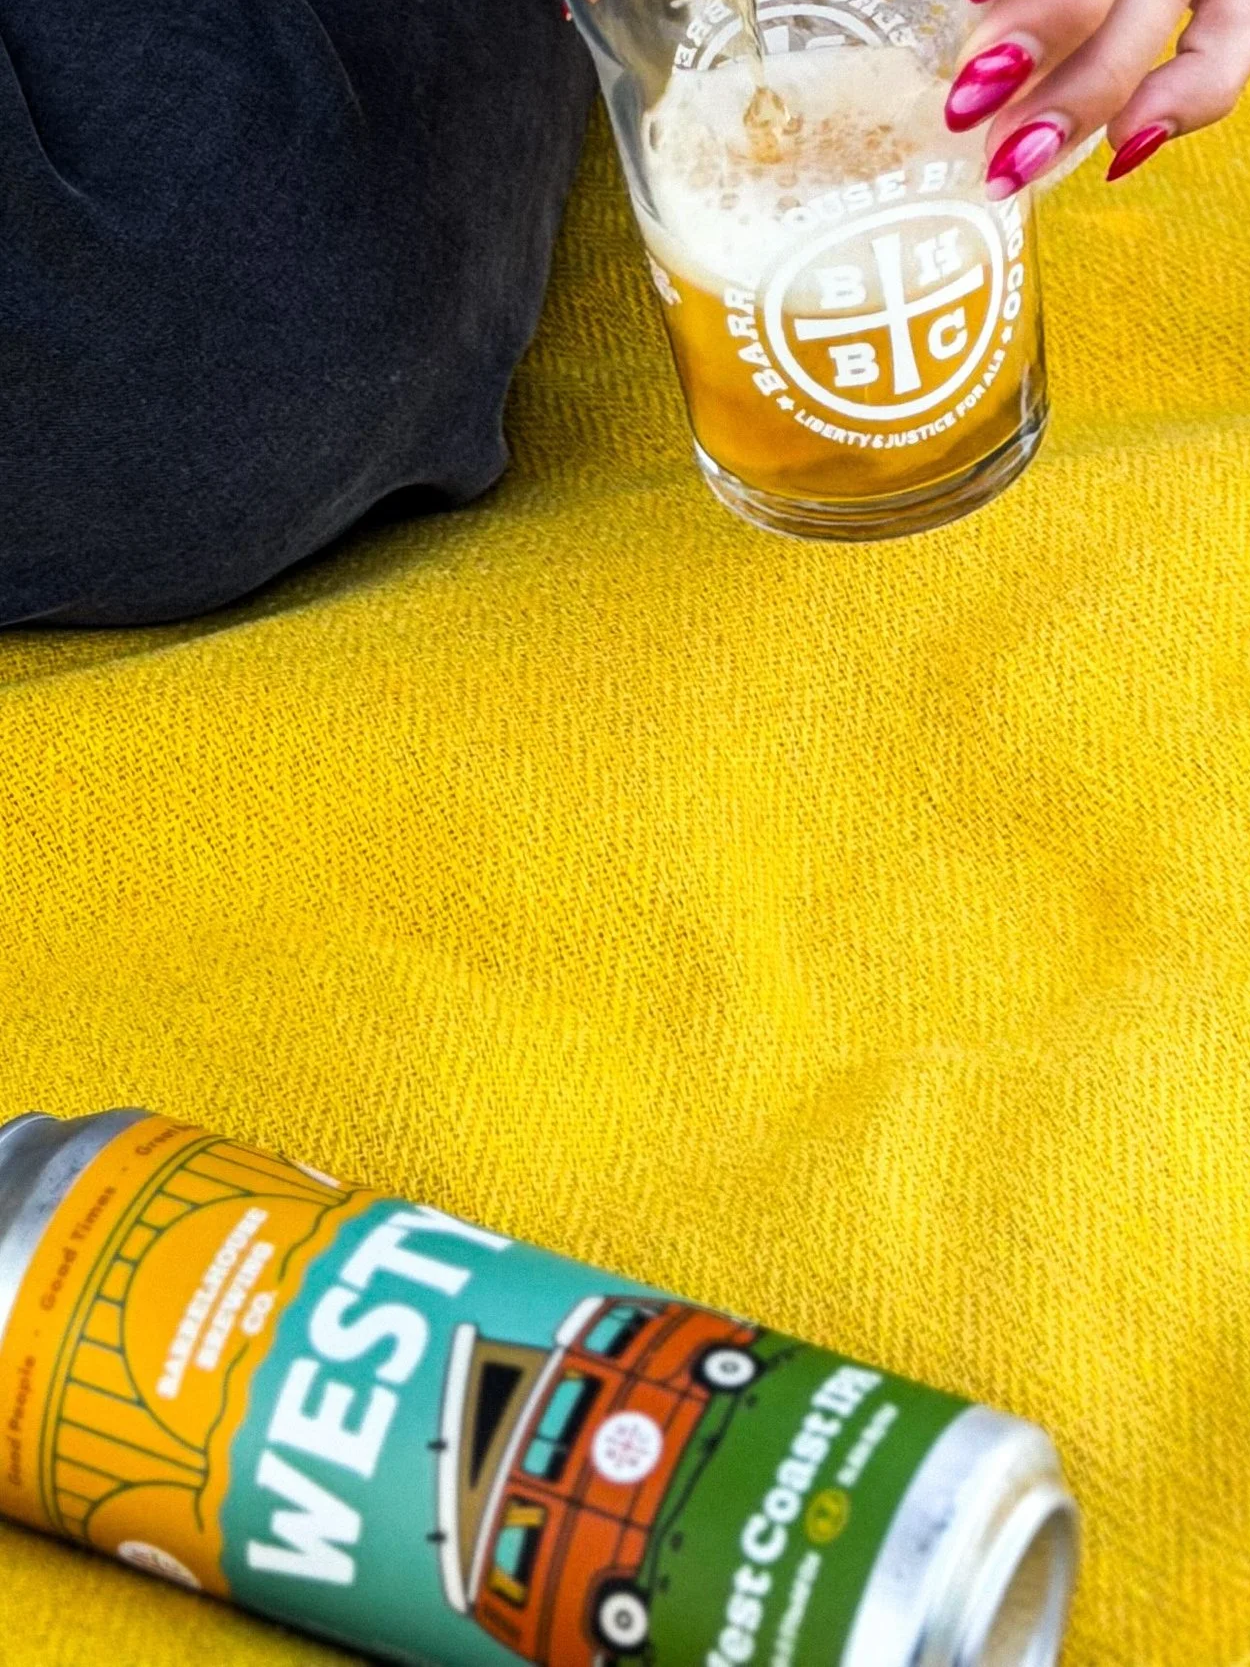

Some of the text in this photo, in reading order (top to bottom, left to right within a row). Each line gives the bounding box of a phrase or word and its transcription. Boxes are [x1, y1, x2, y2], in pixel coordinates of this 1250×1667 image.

[829, 307, 968, 388] B C
[794, 409, 872, 448] LIBERTY
[884, 411, 957, 449] JUSTICE
[956, 385, 986, 418] FOR
[40, 1246, 77, 1312] Good
[71, 1186, 117, 1245] Times
[155, 1207, 269, 1400] BARRELHOUSE
[706, 1563, 772, 1667] est
[740, 1411, 841, 1565] Coast
